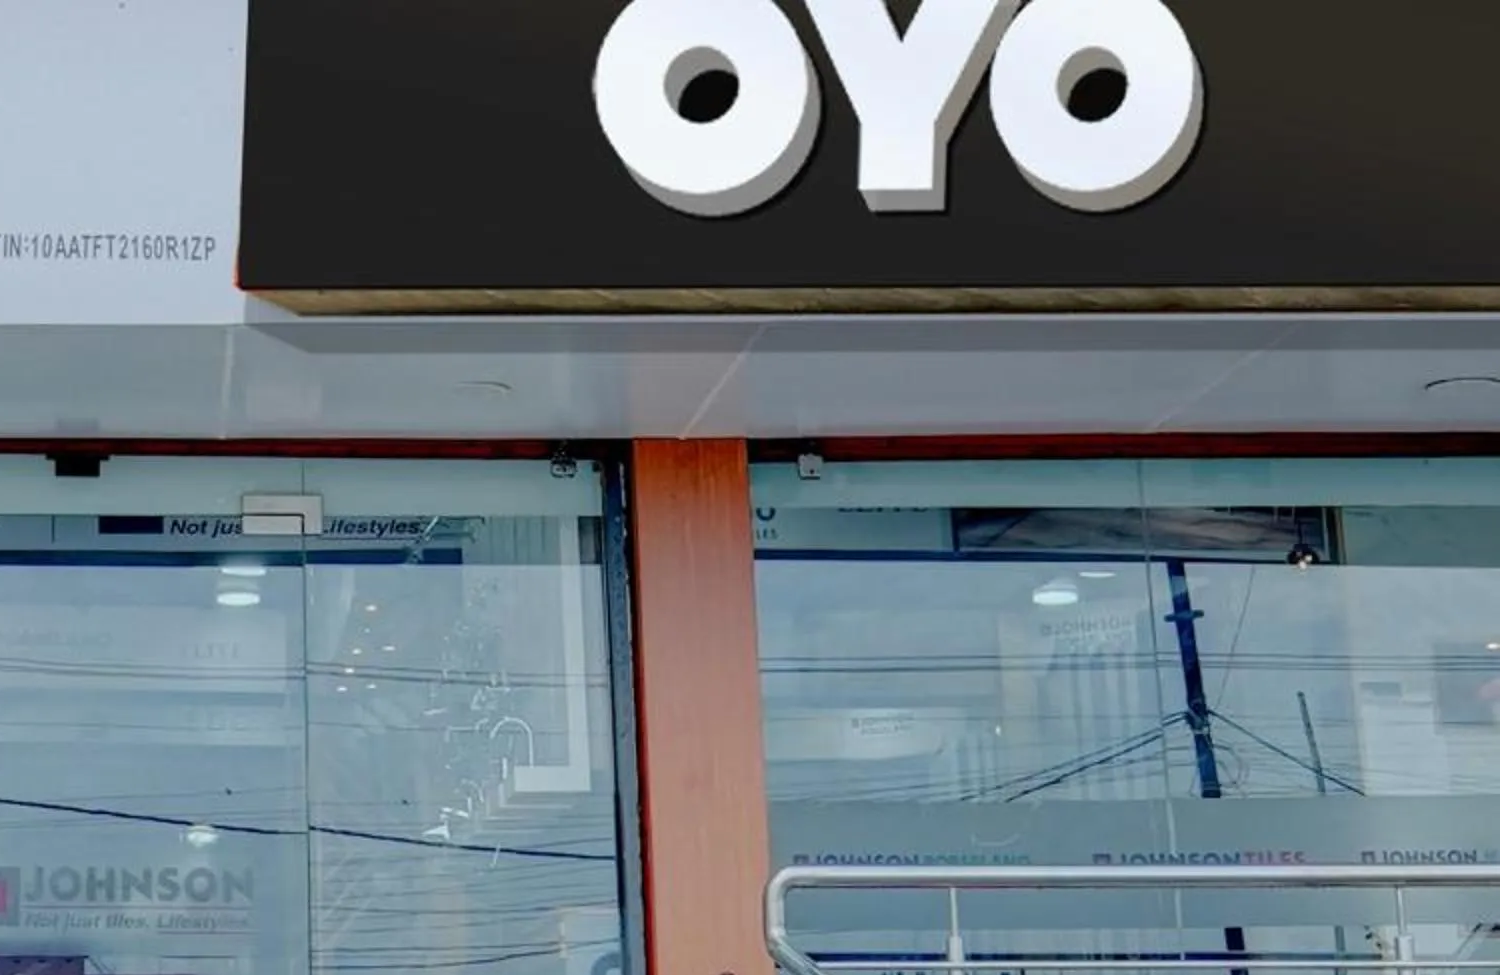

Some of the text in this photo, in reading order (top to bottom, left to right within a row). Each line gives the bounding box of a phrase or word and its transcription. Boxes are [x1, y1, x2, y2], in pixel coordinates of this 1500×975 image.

[593, 0, 1203, 216] OYO
[170, 518, 426, 538] Not jus ifestyles.
[24, 866, 254, 901] JOHNSON
